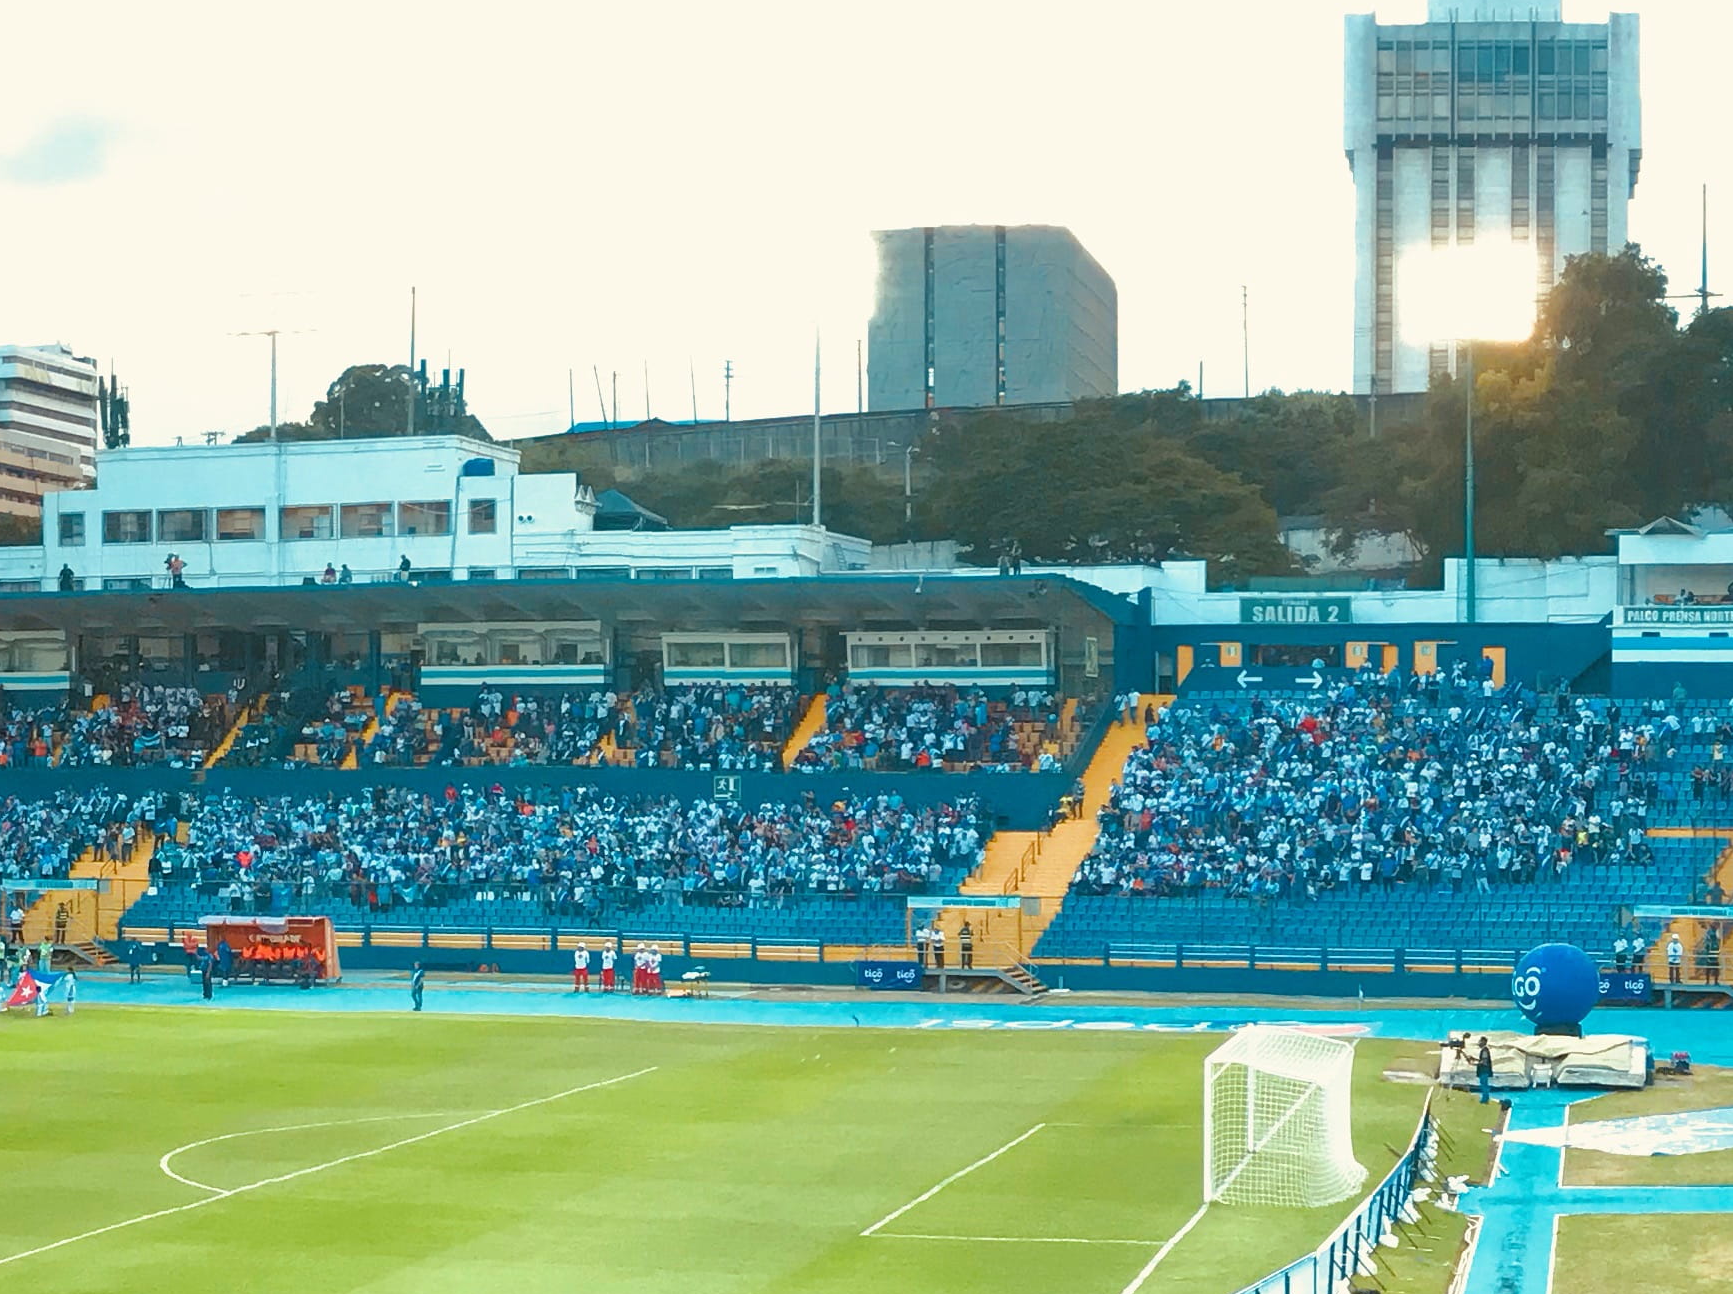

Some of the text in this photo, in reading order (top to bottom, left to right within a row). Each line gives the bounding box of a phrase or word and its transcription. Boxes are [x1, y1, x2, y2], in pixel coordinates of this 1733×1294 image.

[1252, 605, 1339, 622] SALIDA 2
[1627, 610, 1659, 621] PALCO
[1662, 610, 1702, 622] PRENSA
[864, 968, 915, 983] tigo tigo
[1625, 979, 1644, 994] tigo
